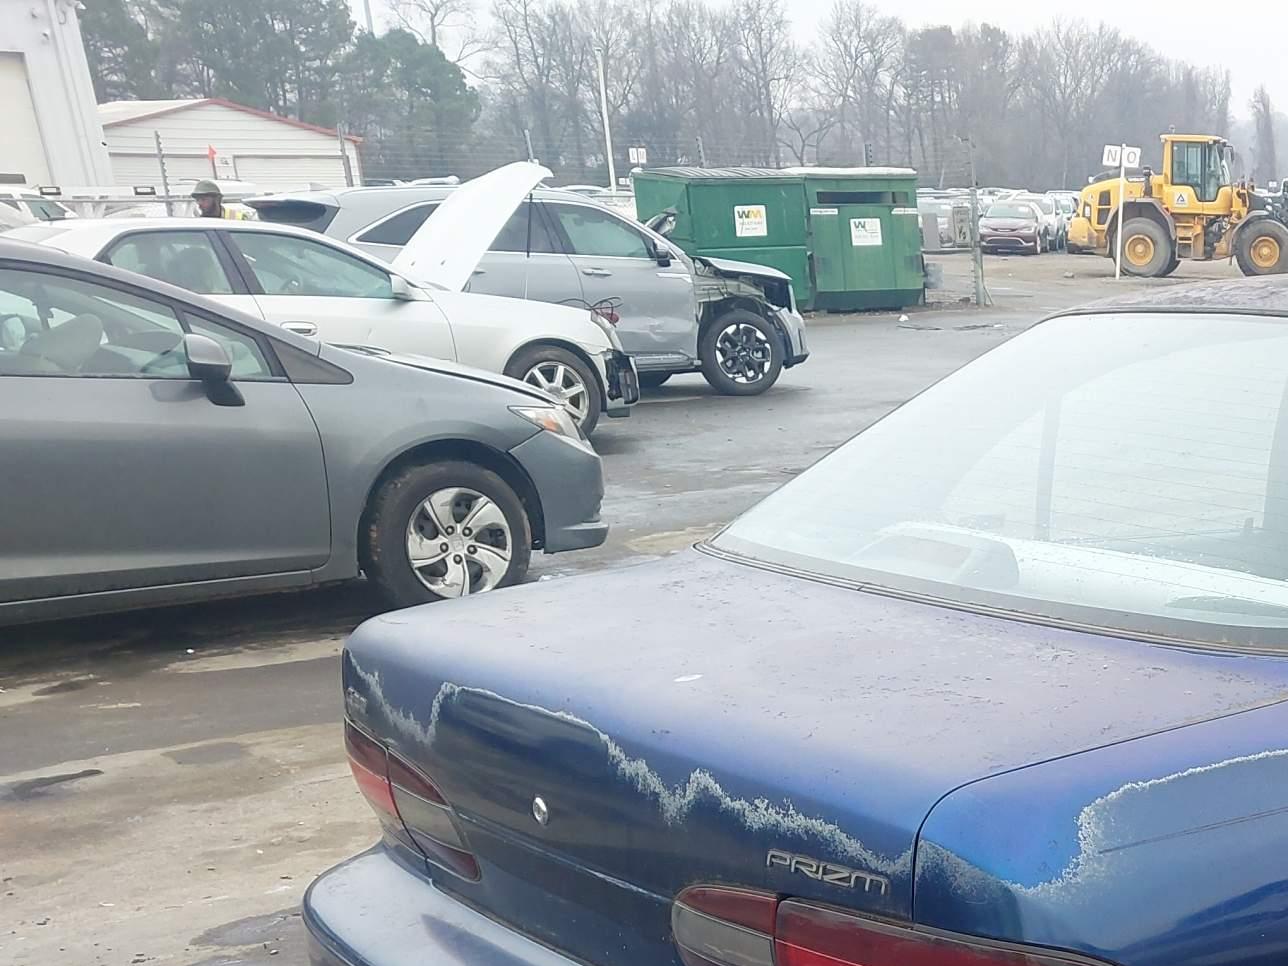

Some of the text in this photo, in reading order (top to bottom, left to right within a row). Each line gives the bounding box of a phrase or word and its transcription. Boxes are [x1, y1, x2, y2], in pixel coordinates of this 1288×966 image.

[1106, 149, 1117, 163] N
[1126, 151, 1137, 164] O
[766, 848, 890, 896] PRIZM
